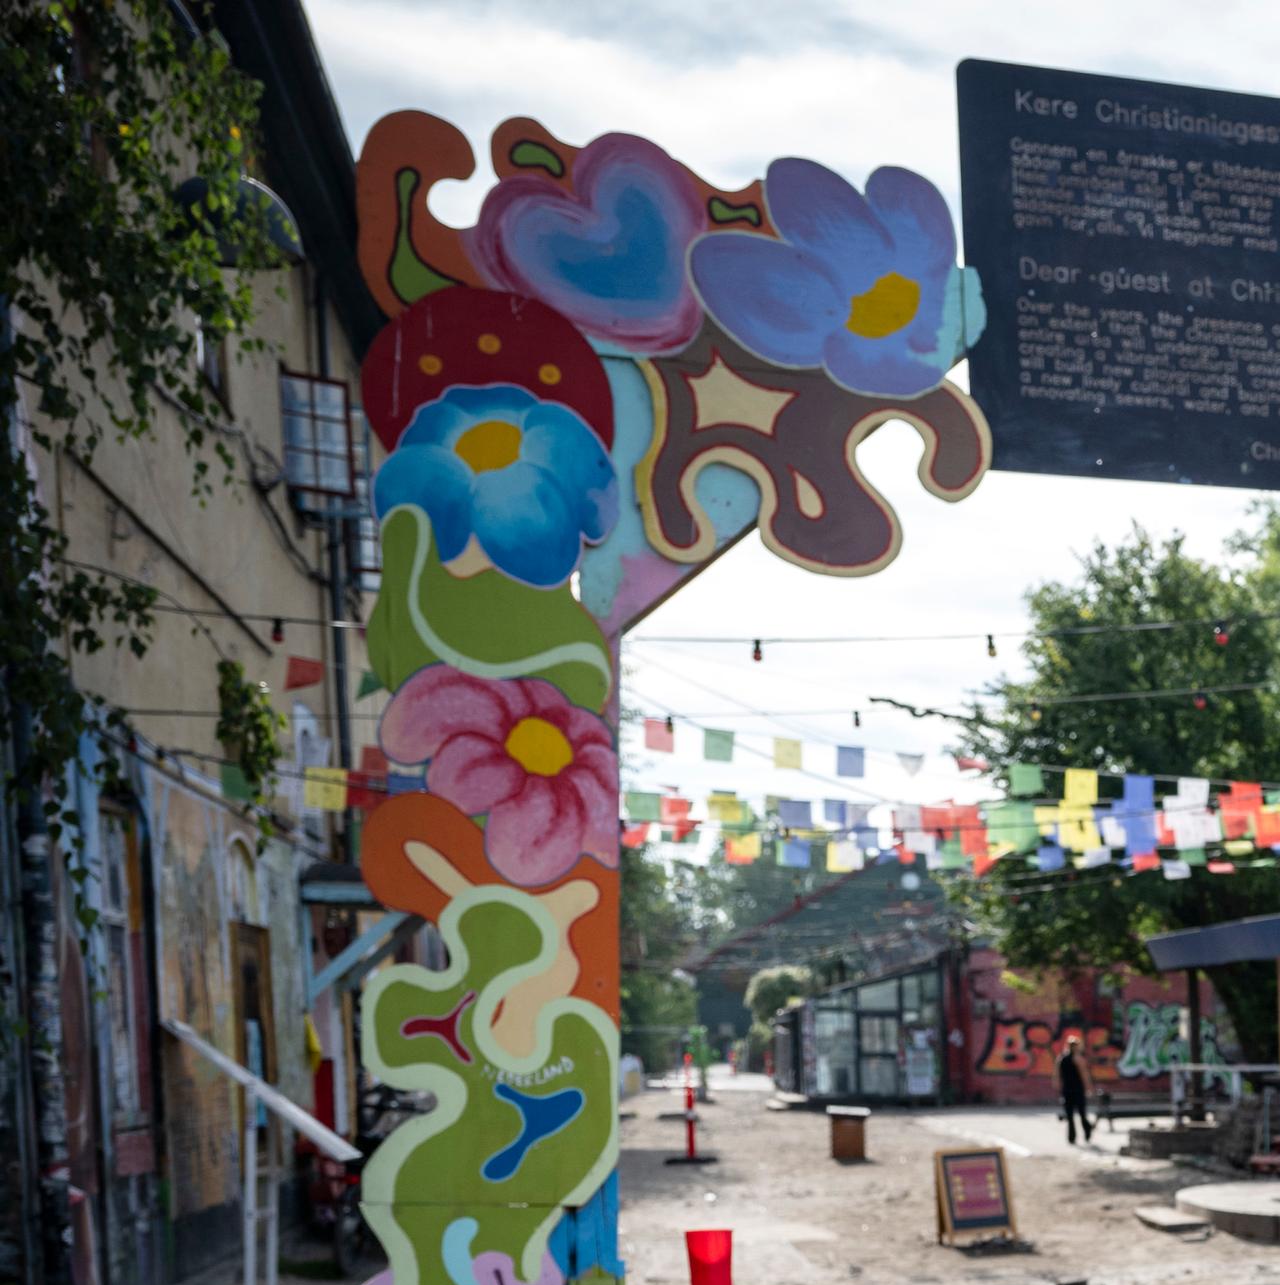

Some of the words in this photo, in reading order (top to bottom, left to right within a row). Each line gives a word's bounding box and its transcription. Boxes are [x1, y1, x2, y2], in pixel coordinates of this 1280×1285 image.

[1020, 257, 1079, 284] Dear
[1099, 266, 1169, 298] guest
[1188, 275, 1213, 297] at
